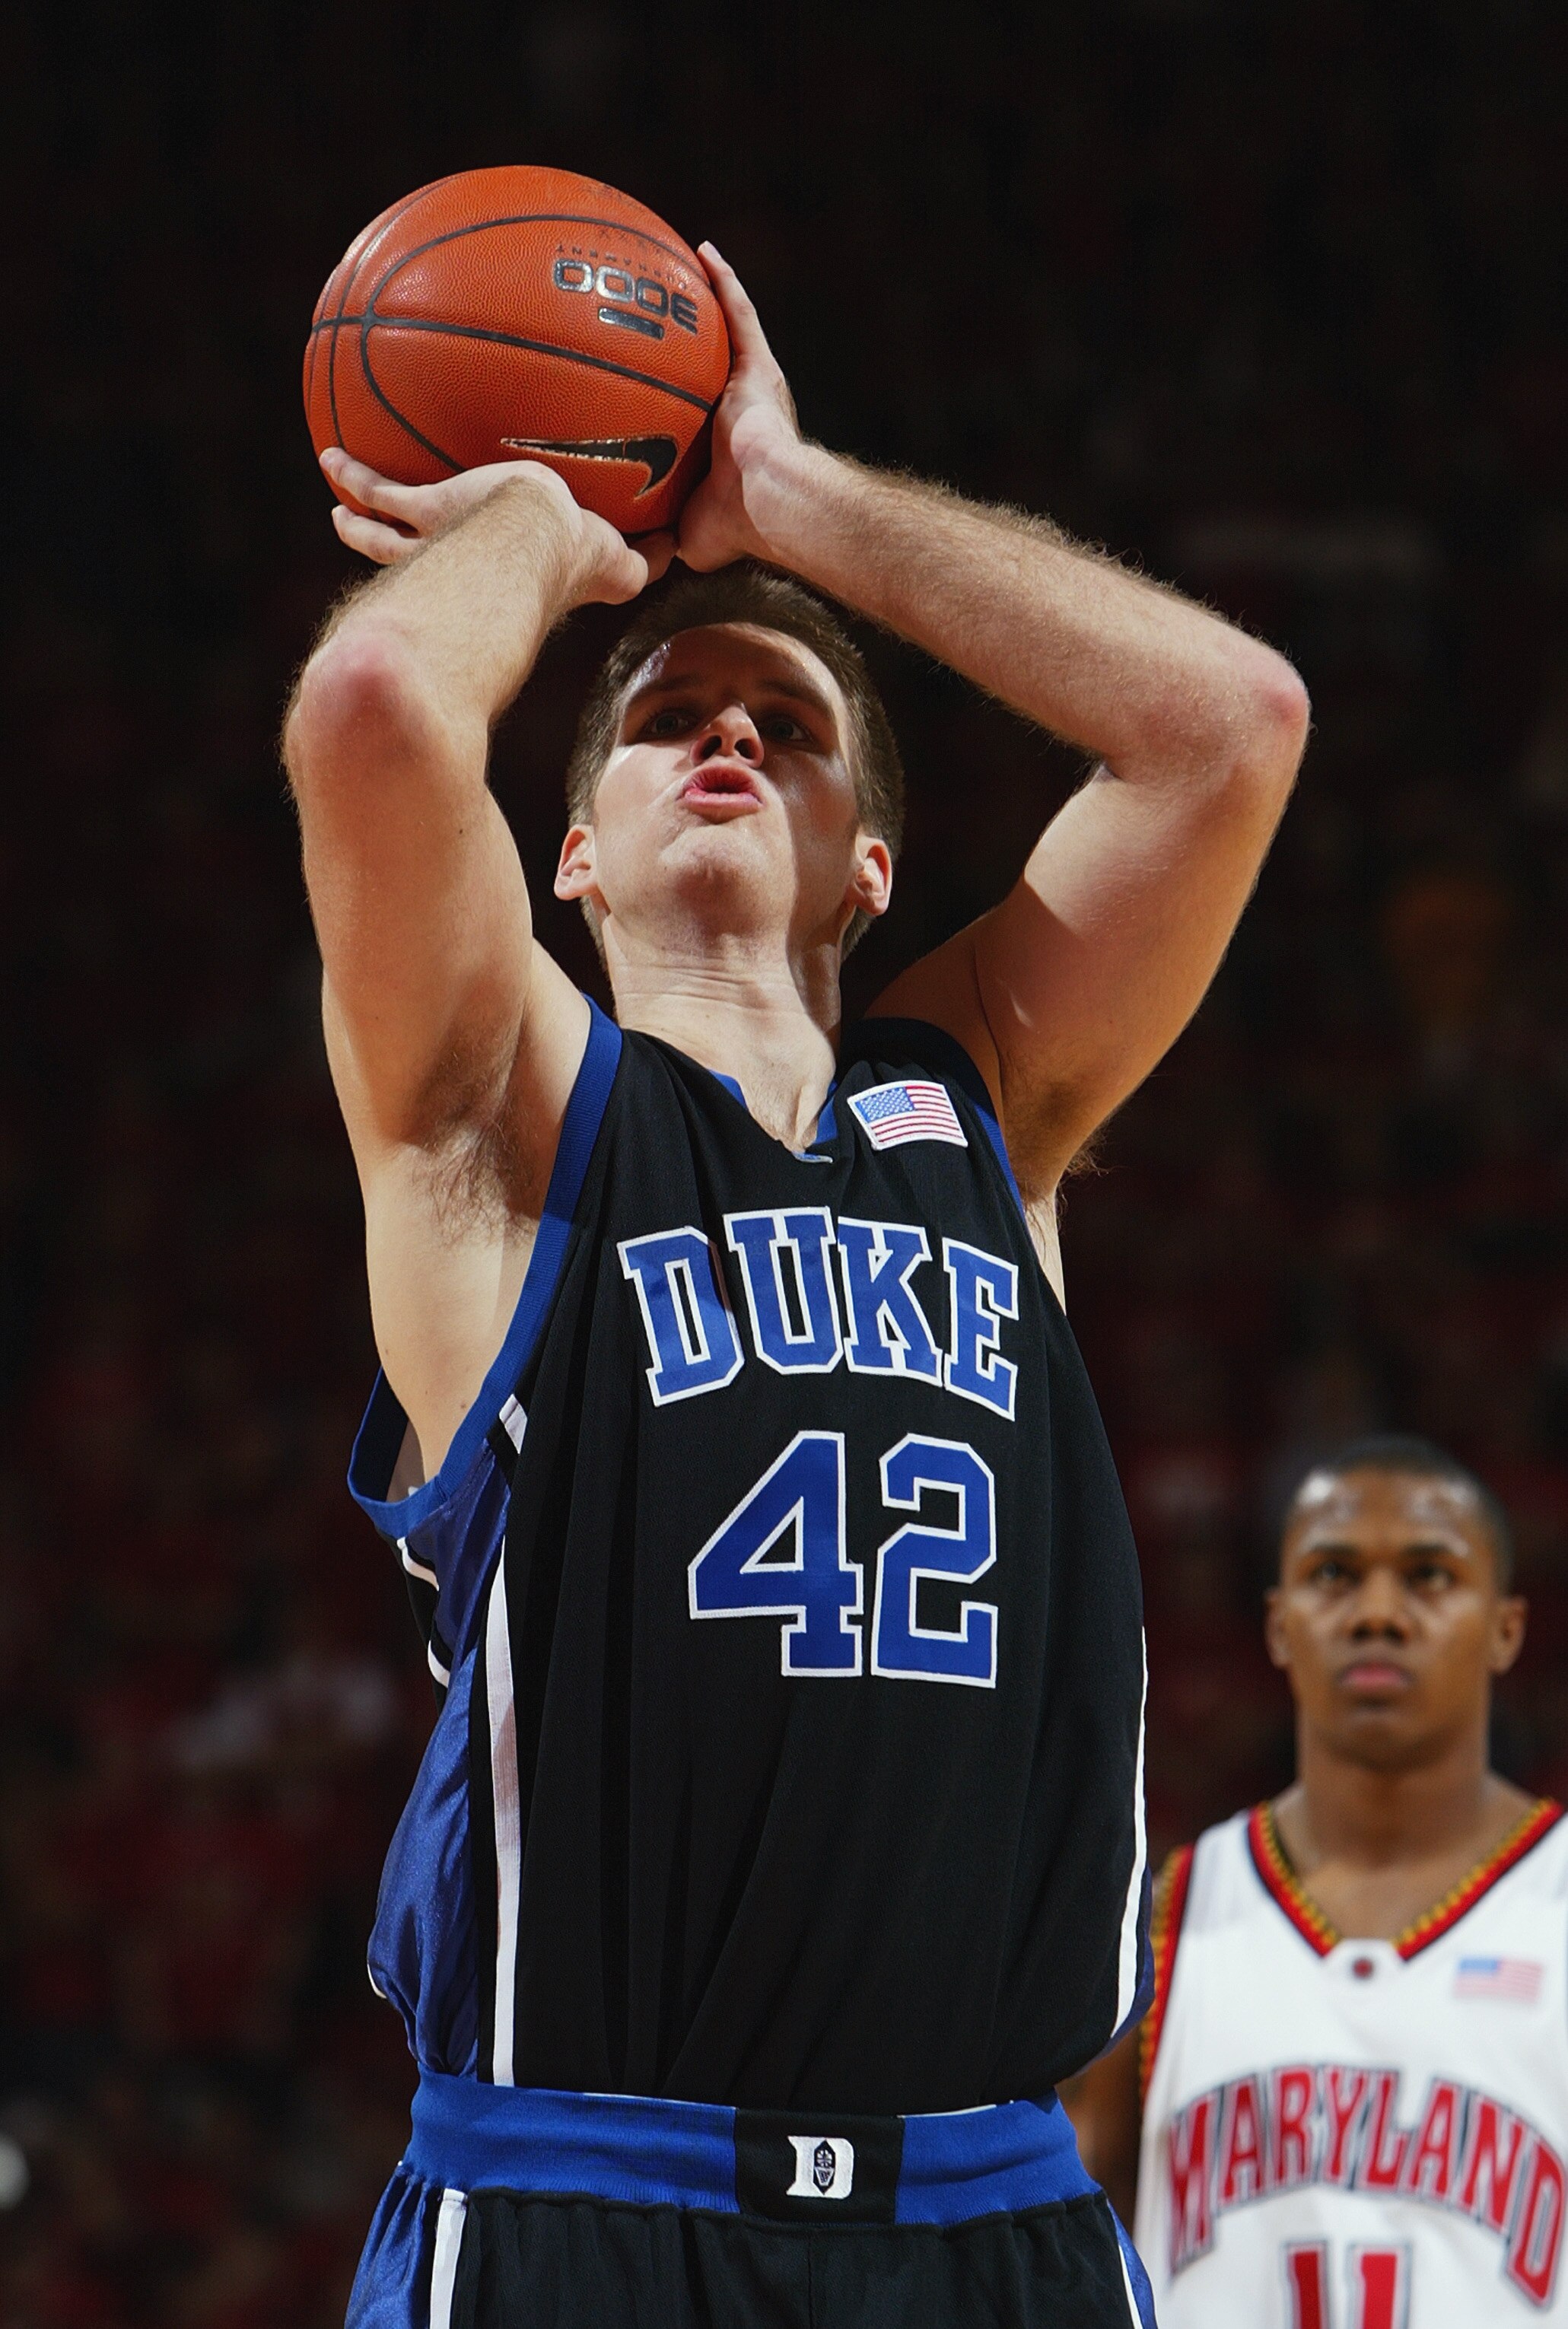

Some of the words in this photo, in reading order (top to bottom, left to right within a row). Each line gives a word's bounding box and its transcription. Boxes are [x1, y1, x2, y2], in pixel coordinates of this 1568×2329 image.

[552, 257, 698, 336] 3000
[616, 1206, 1019, 1421] DUKE
[688, 1430, 998, 1688] 42
[1168, 2063, 1568, 2311] MARYLAND
